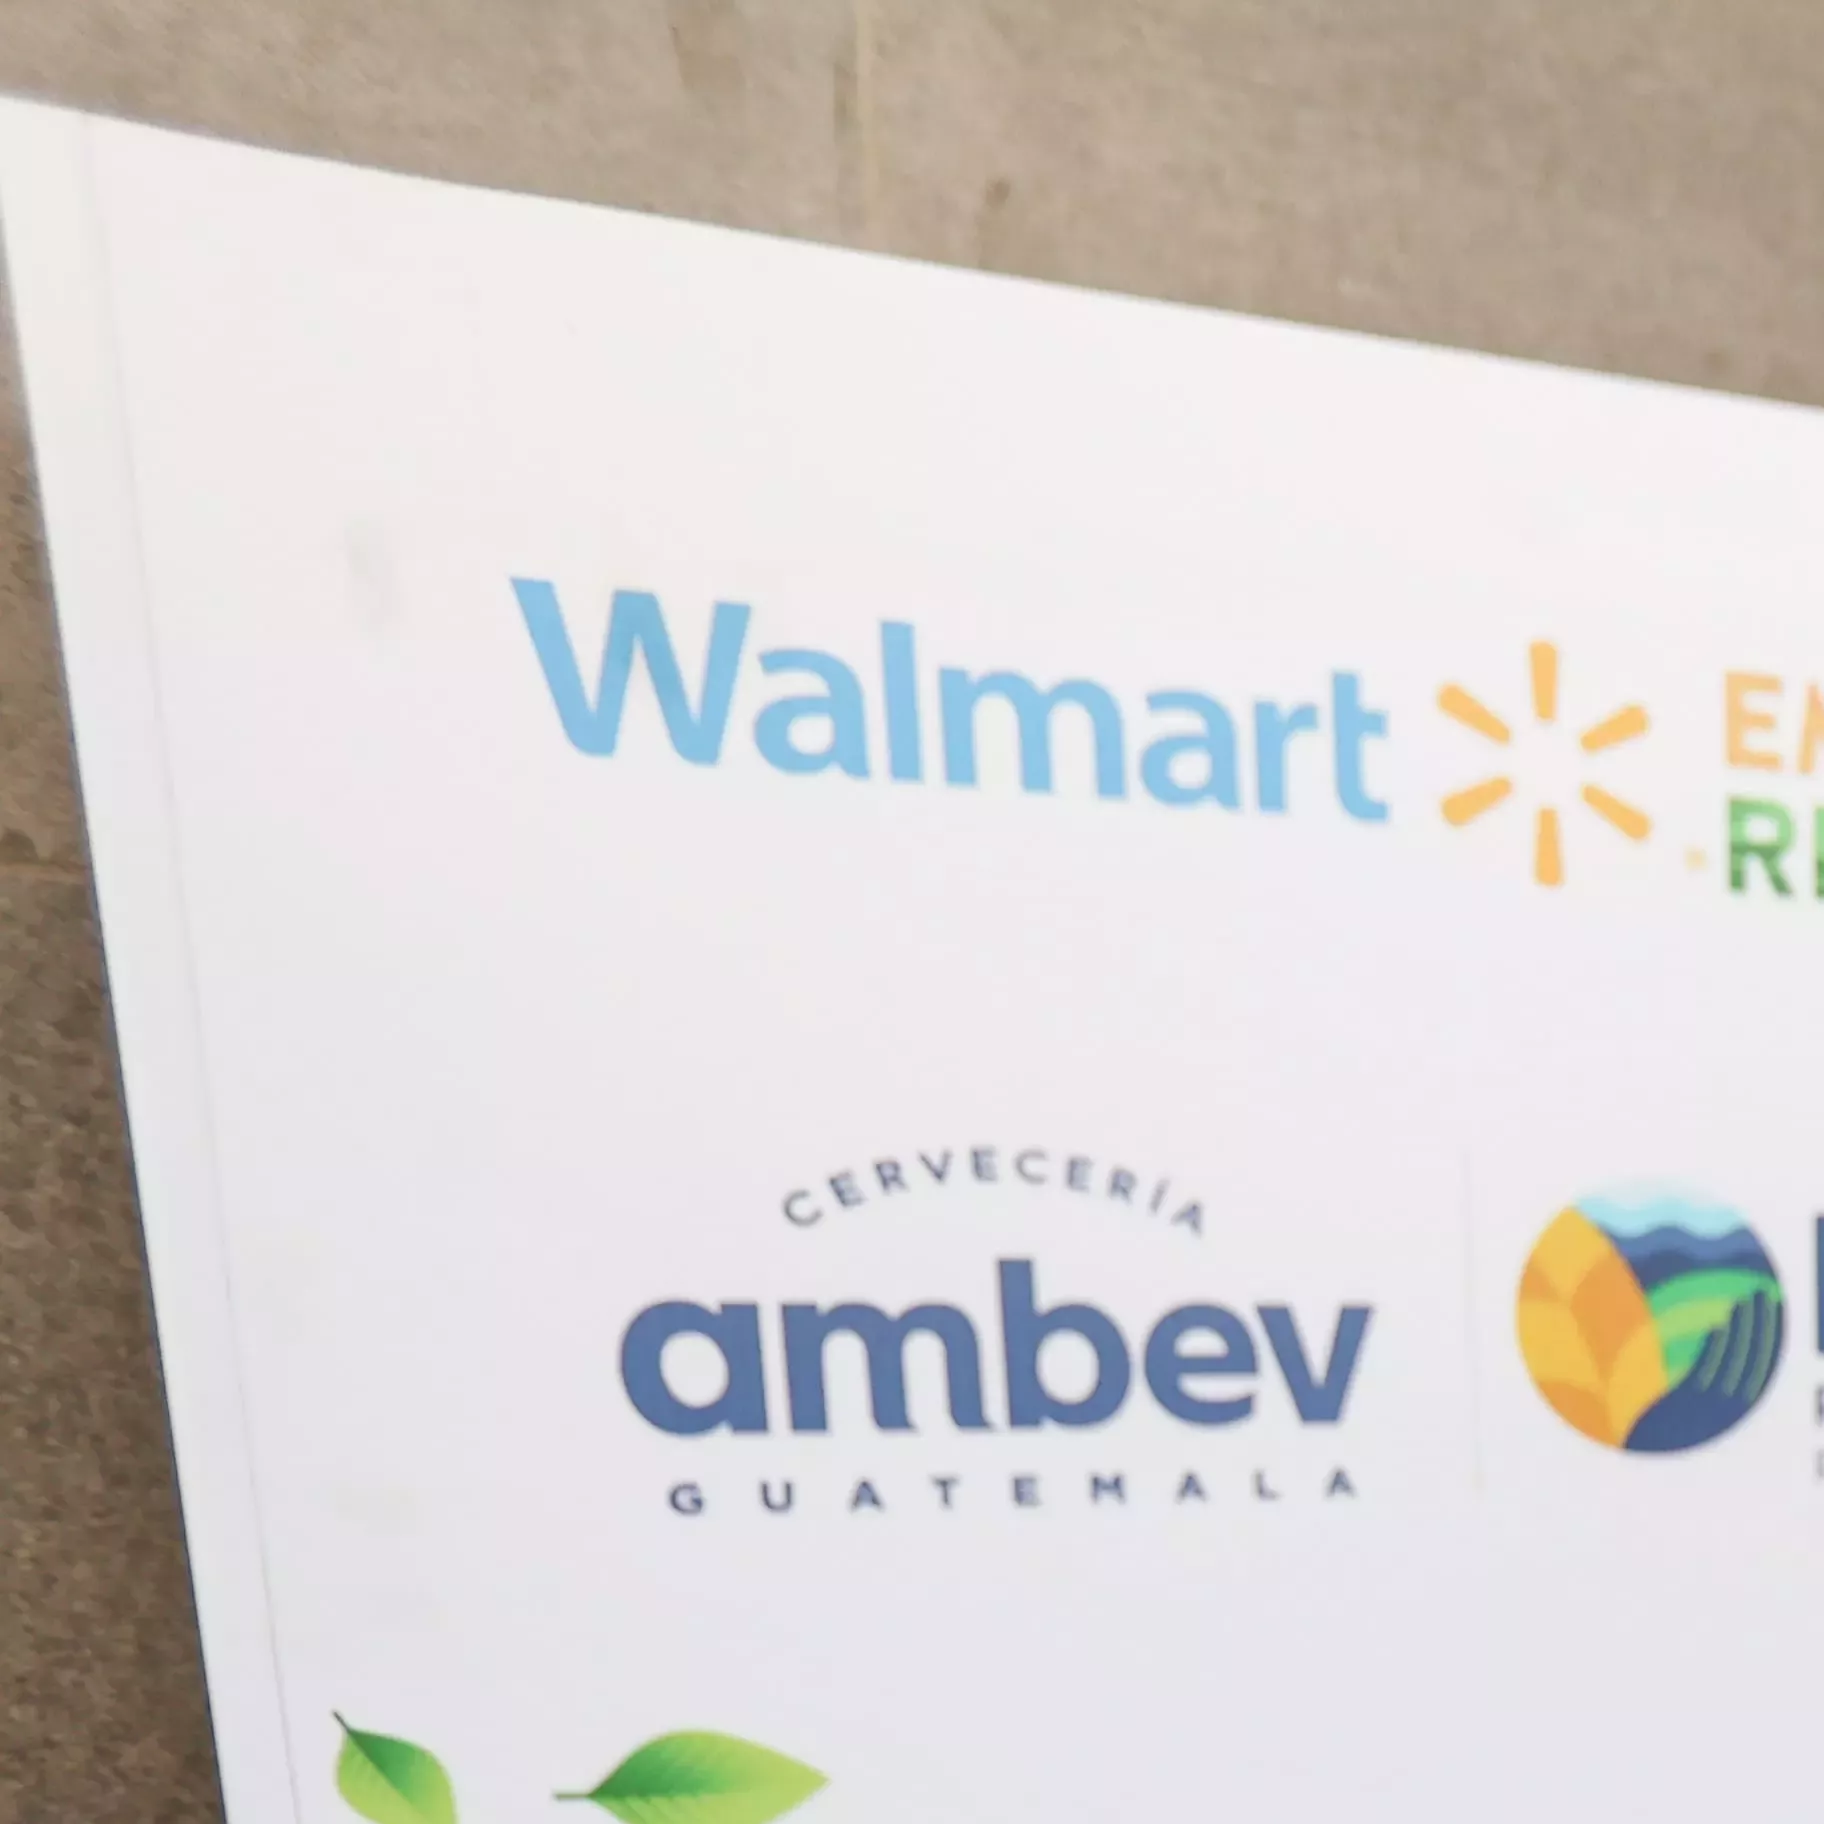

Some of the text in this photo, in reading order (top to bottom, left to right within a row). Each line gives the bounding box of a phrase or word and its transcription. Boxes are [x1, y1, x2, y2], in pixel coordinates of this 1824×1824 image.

[510, 576, 1388, 823] Walmart
[620, 1257, 1375, 1436] ambev
[668, 1467, 1357, 1516] GUATEMALA
